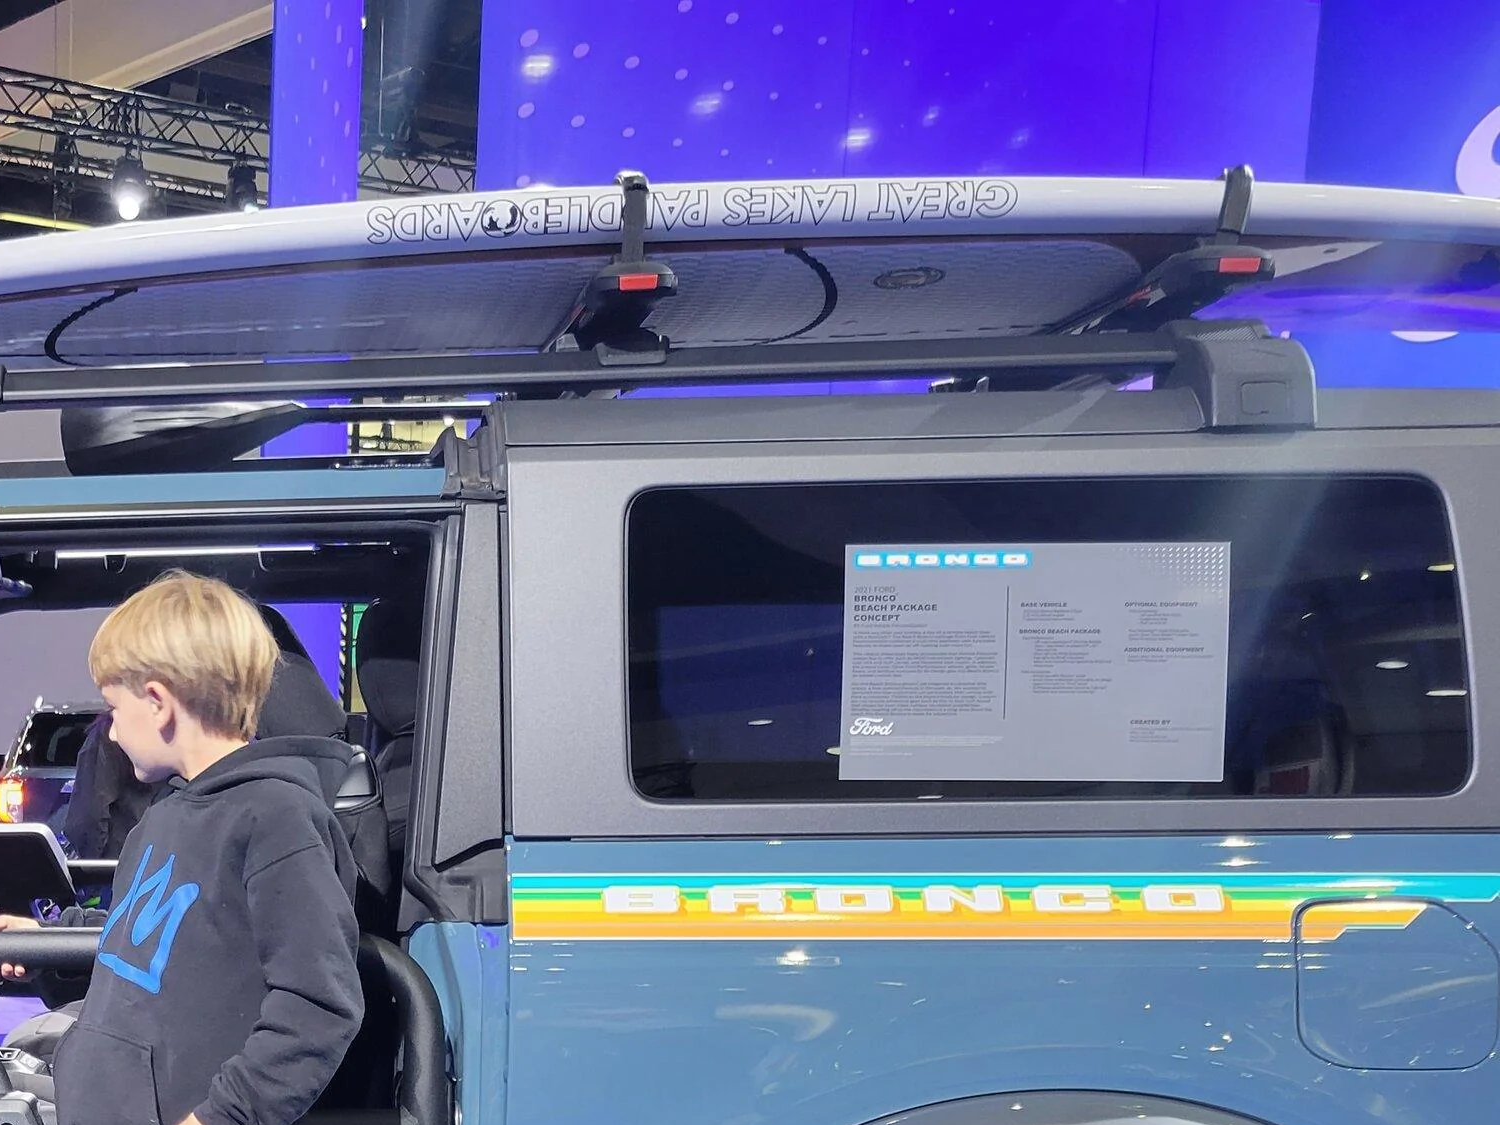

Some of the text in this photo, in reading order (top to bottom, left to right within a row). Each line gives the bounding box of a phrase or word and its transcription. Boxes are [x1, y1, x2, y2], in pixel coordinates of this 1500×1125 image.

[366, 179, 1019, 245] GREAT LAKES PADLEBOARDS
[853, 586, 896, 594] 2021 FORD
[853, 604, 938, 612] BEACH PACKAGE
[853, 614, 901, 622] CONCEPT
[849, 717, 894, 736] Ford
[601, 883, 1229, 915] BRONCO
